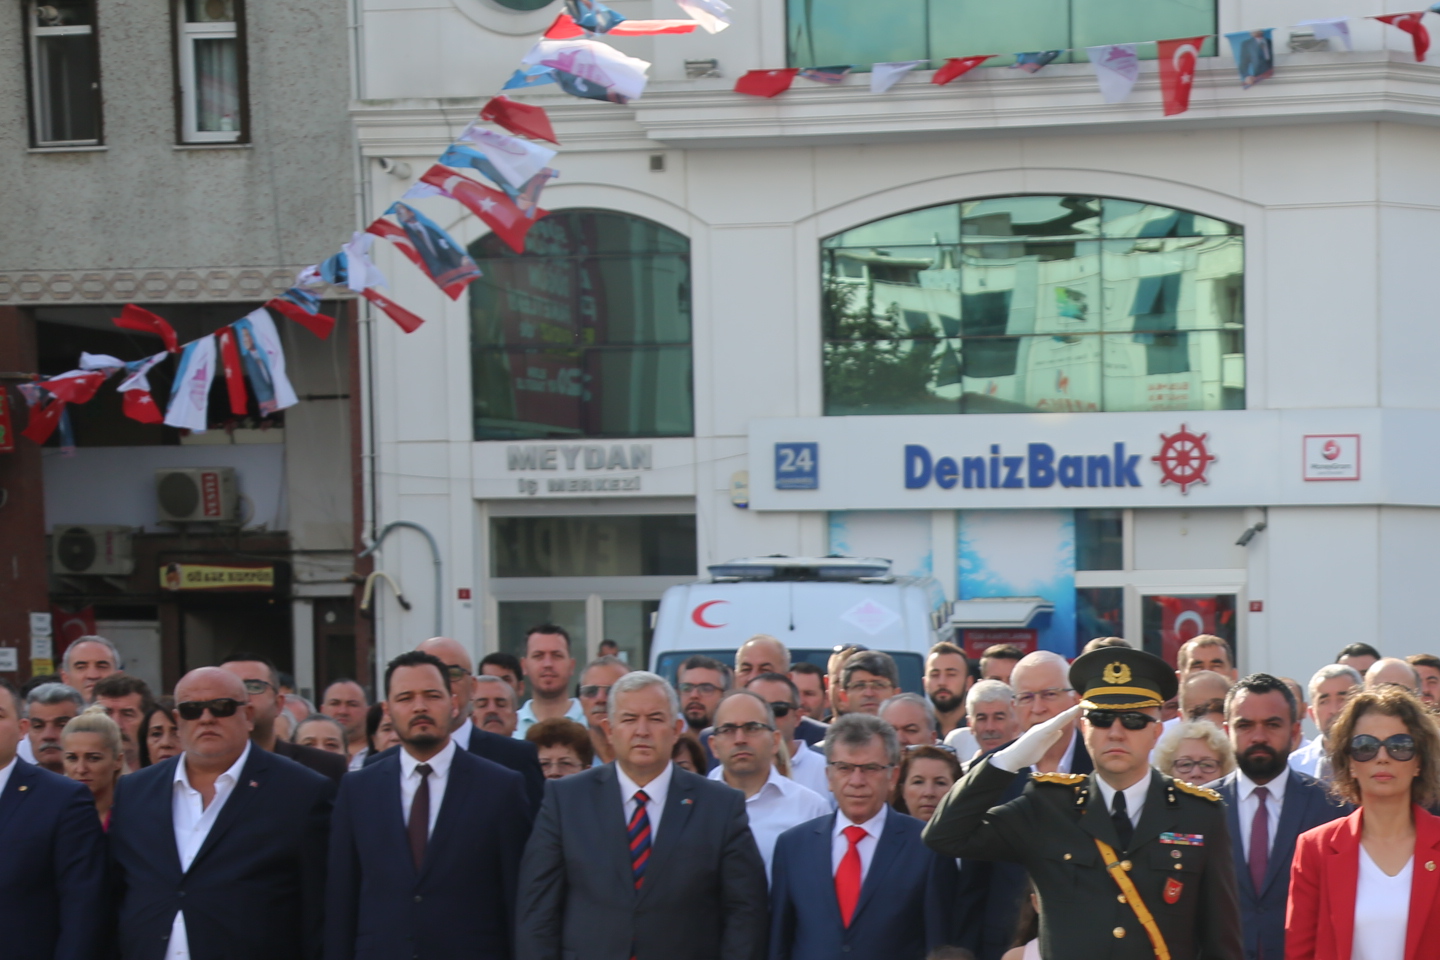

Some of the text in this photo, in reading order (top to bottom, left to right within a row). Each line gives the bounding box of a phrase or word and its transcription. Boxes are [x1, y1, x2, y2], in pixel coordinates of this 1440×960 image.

[506, 443, 653, 471] MEYDAN
[779, 447, 815, 473] 24
[903, 441, 1143, 490] DenizBank
[547, 475, 641, 493] MERKEZİ
